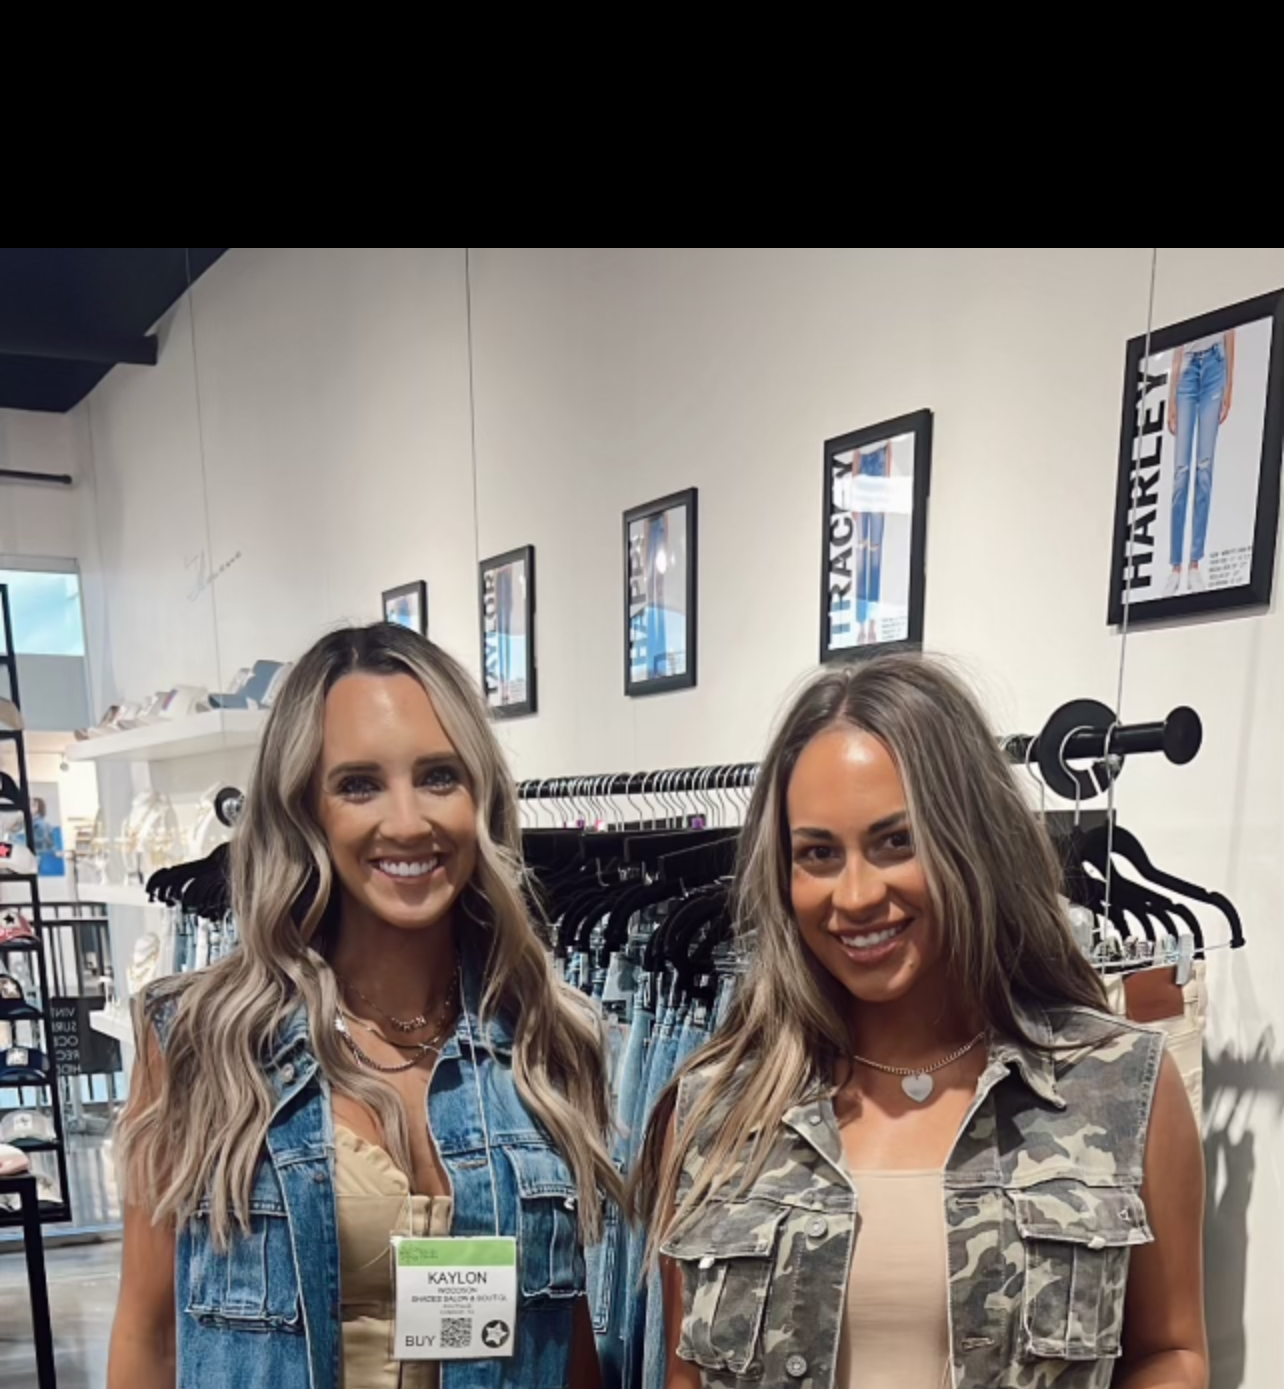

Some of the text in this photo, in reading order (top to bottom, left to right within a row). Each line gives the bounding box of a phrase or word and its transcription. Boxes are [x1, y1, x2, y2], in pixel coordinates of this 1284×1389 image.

[1121, 372, 1168, 591] HARLEY
[428, 1271, 487, 1285] KAYLON
[405, 1335, 435, 1347] BUY
